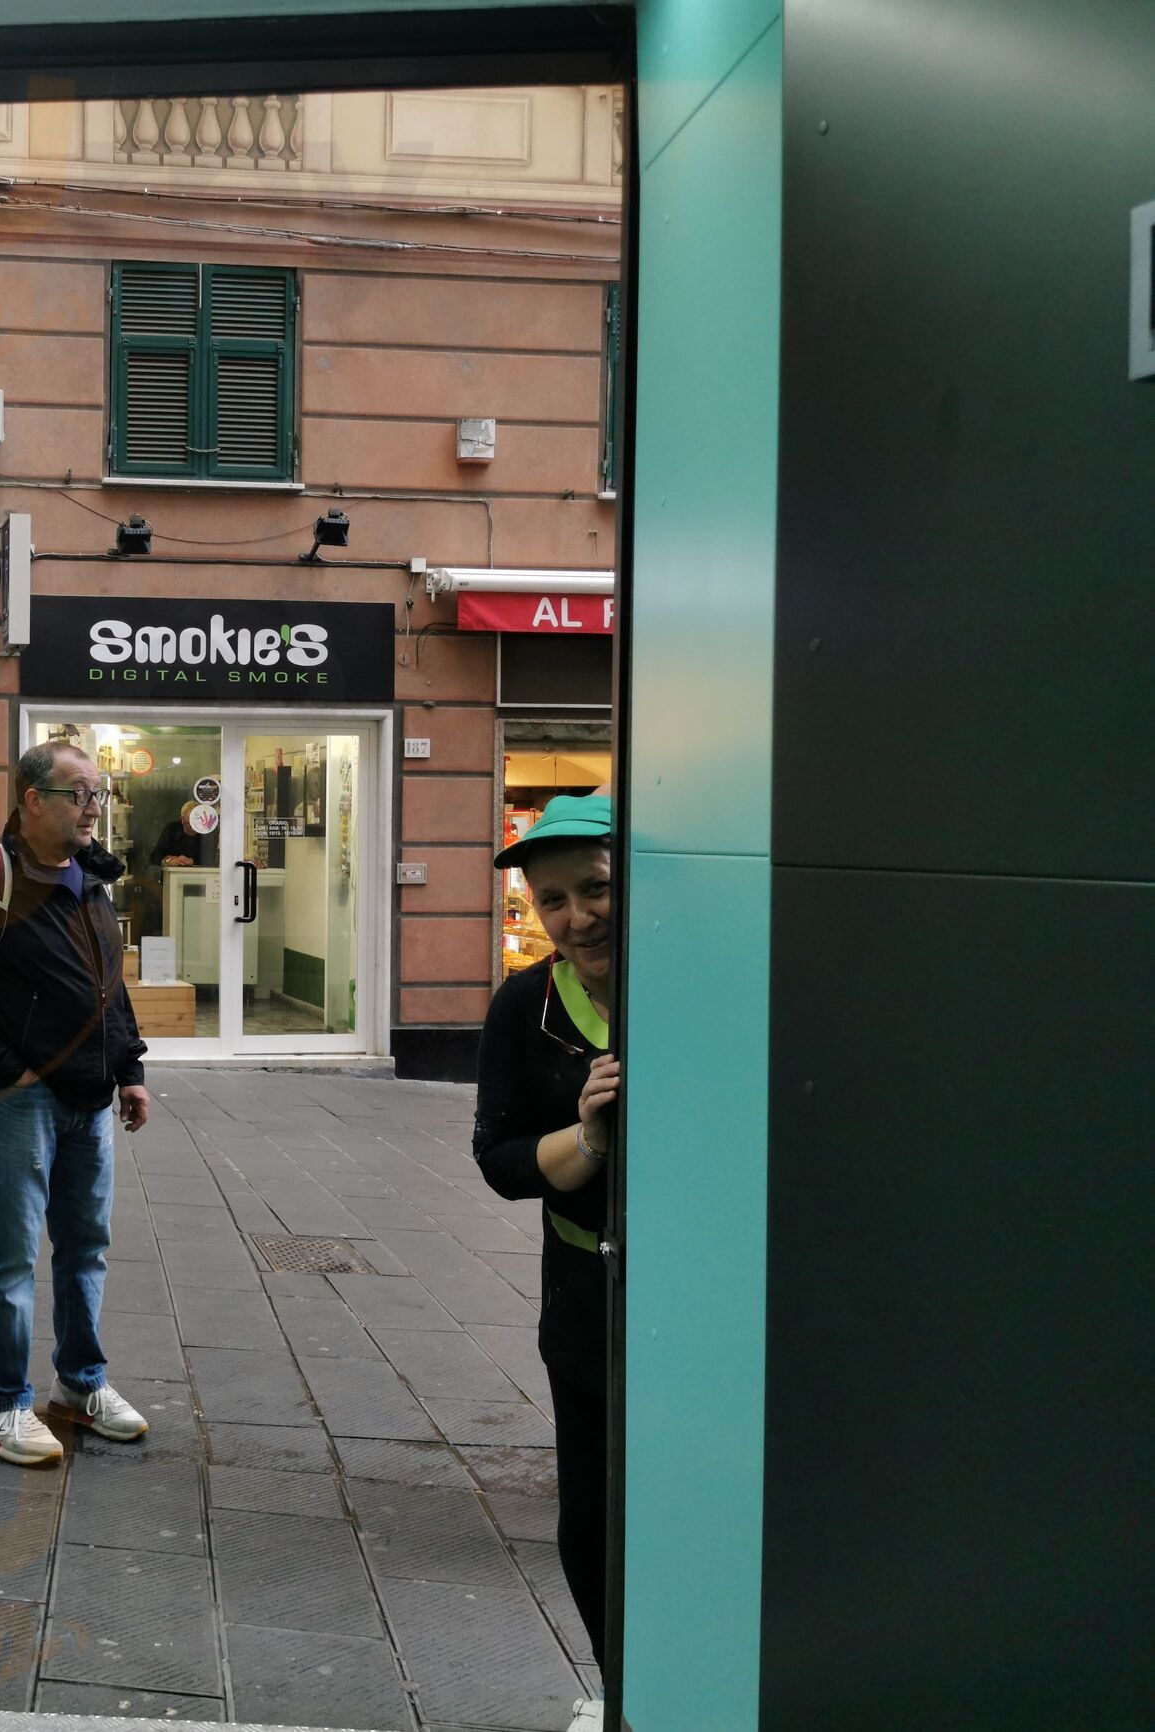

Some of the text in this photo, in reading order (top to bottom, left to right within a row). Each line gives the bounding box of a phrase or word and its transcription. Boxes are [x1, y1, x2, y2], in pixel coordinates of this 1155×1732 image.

[532, 597, 583, 628] AL
[89, 668, 329, 684] DIGITAL SMOKE
[406, 741, 428, 754] 187
